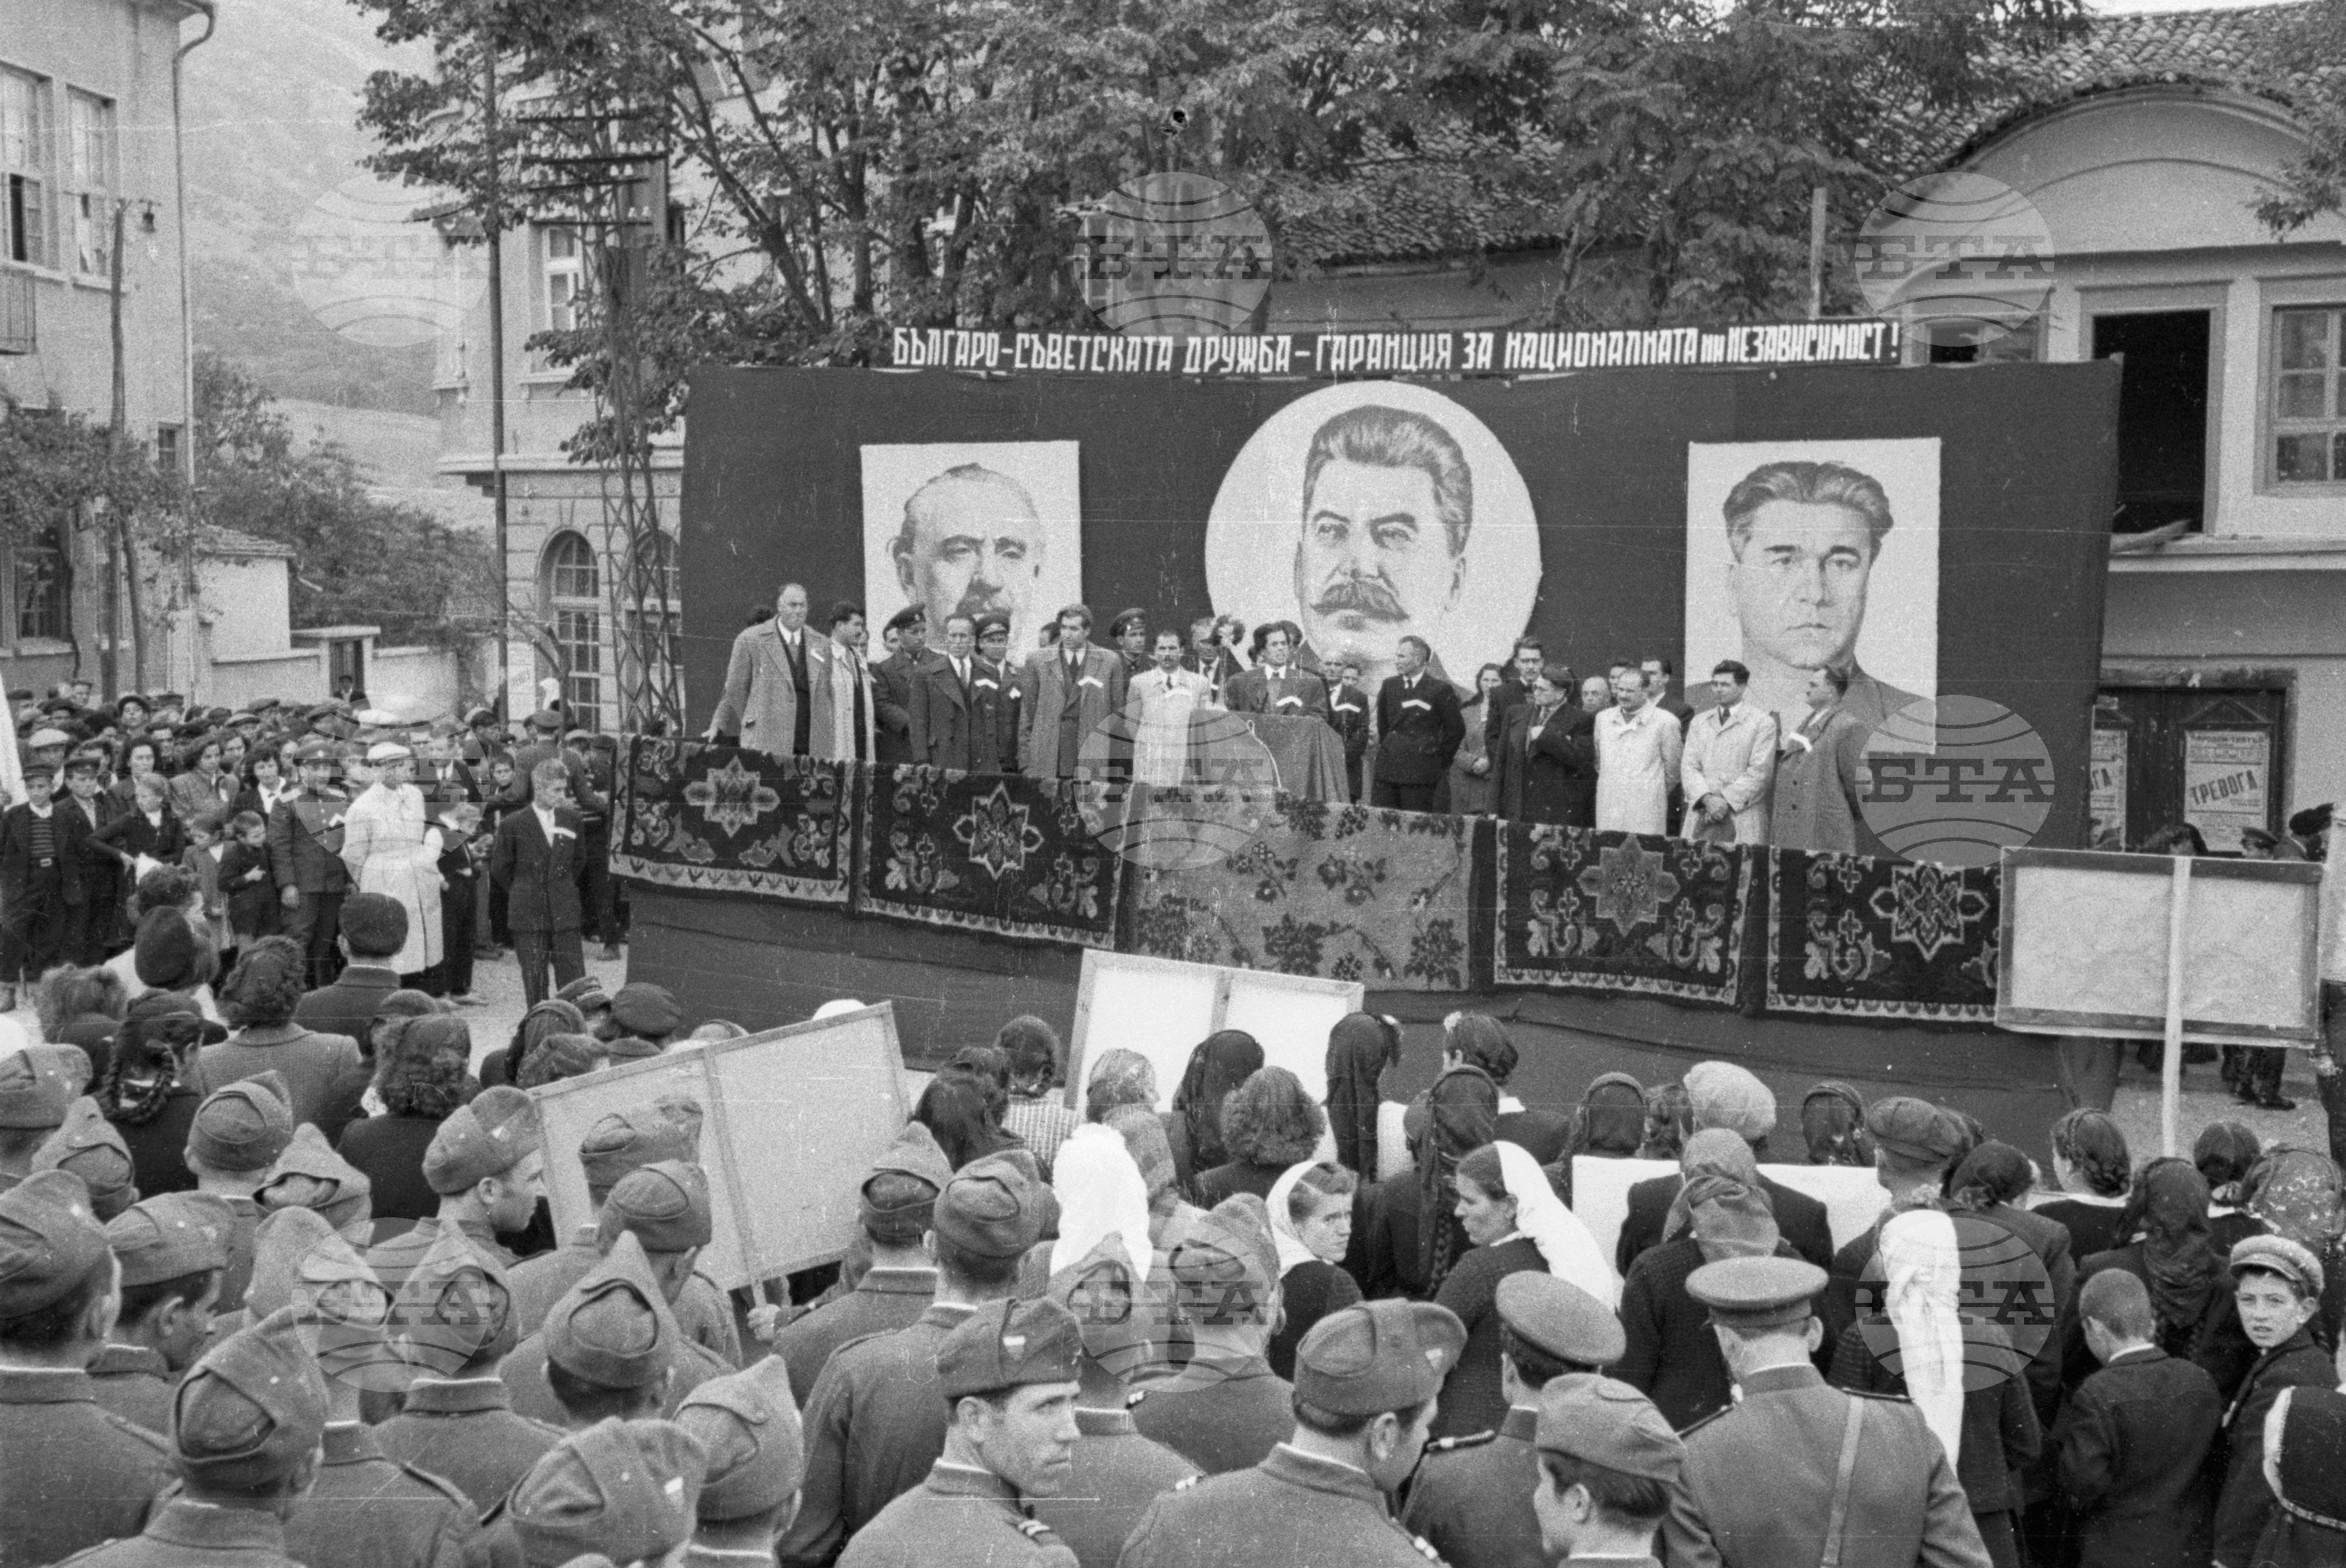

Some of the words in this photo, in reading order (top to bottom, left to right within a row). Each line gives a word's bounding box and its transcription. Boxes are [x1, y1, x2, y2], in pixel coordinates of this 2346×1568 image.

[1182, 335, 1291, 374] ДРУЖБА
[1316, 333, 1452, 372] ГАРАНЦИЯ
[1462, 332, 1494, 370] ЗА
[1503, 327, 1699, 371] НАЦИОНАЛНАТА
[2190, 769, 2259, 805] ТРЕВОГА
